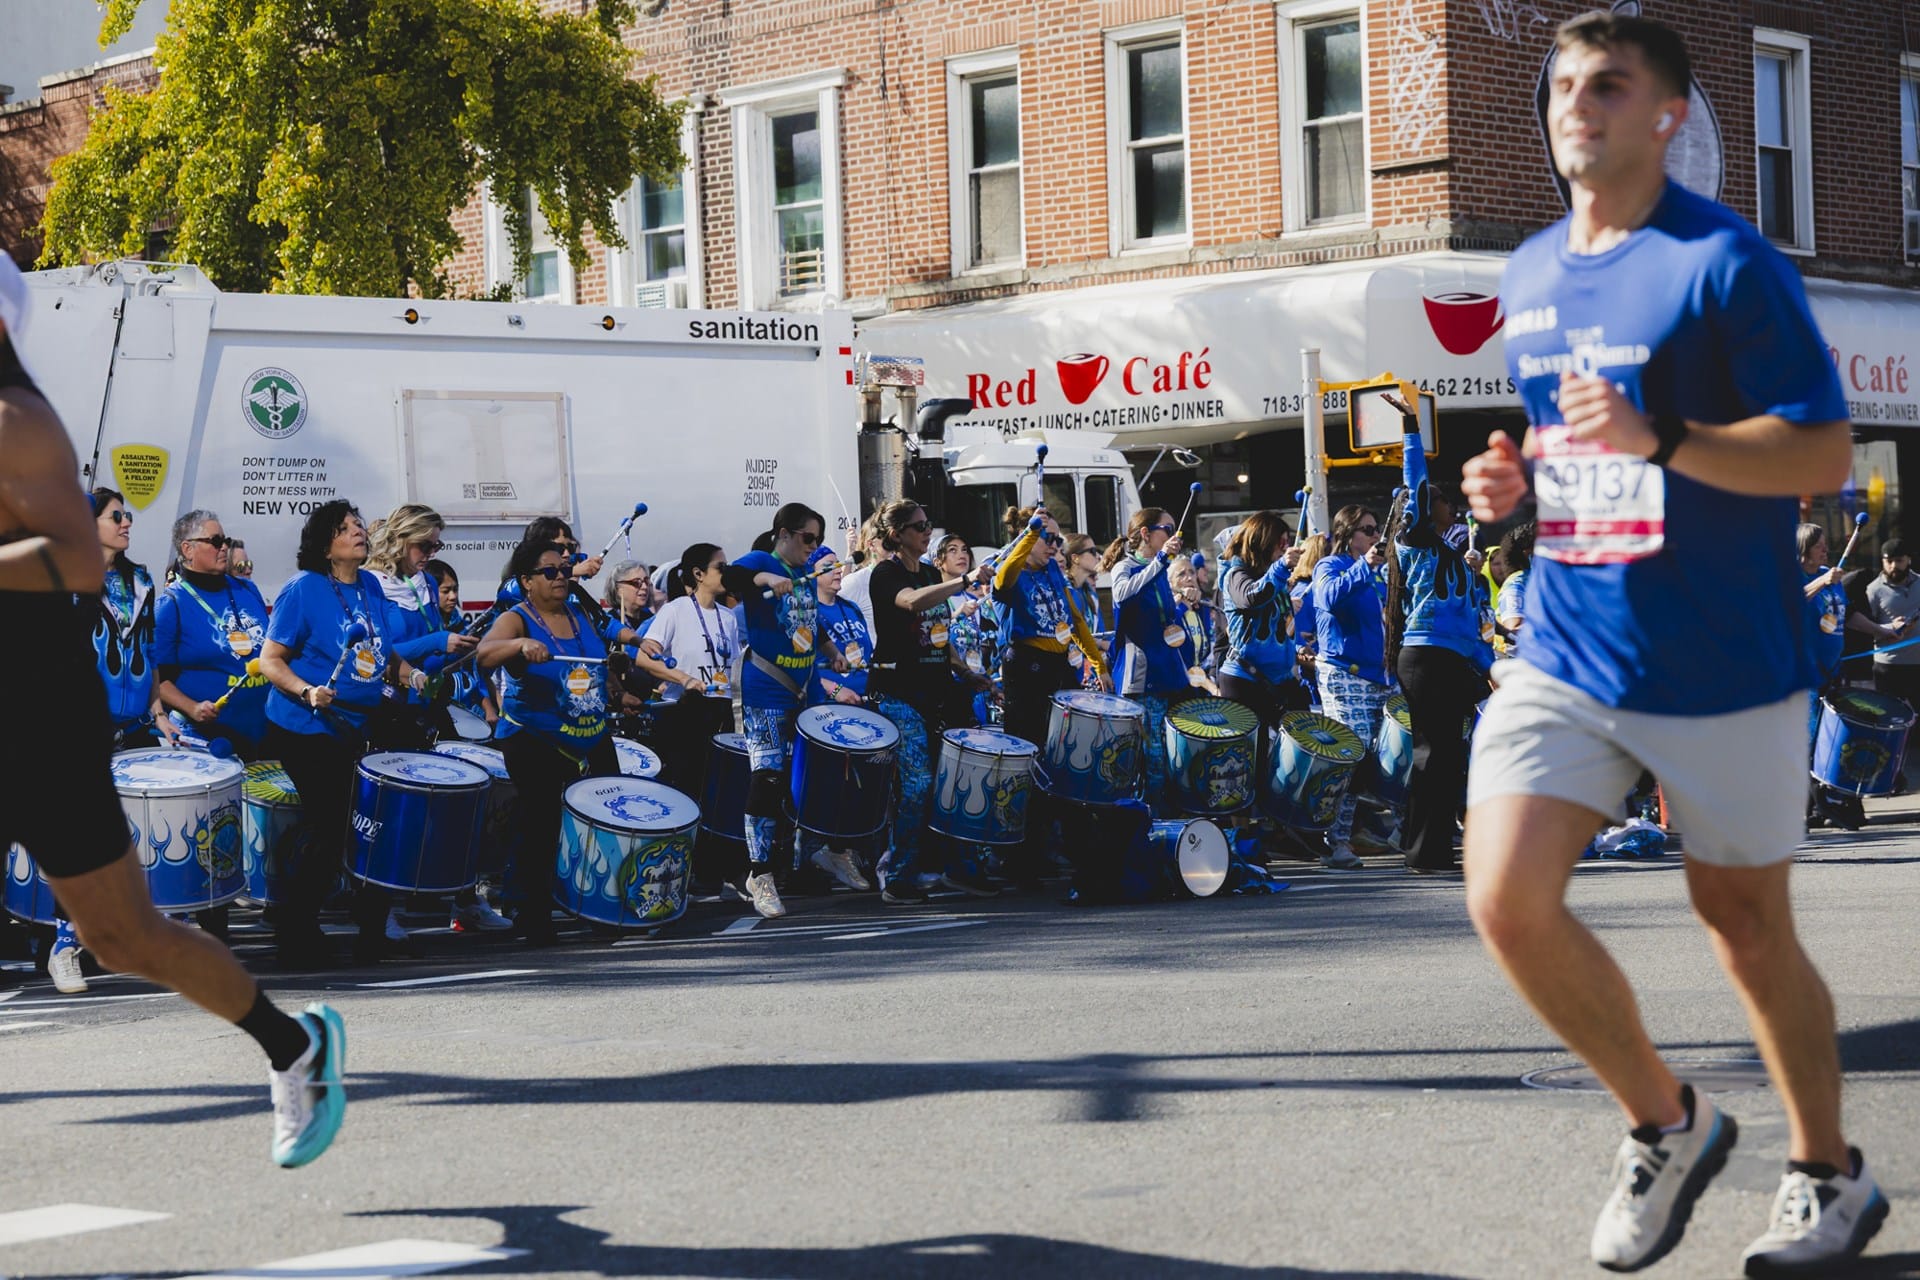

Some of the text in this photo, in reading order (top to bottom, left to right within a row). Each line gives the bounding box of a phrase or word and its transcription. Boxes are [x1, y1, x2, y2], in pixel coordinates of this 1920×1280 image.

[689, 316, 819, 341] sanitation
[252, 371, 264, 382] NEW
[283, 373, 296, 384] CITY
[966, 348, 1212, 410] Red Café
[1850, 354, 1908, 394] Café
[1410, 378, 1456, 396] 4-62
[1463, 377, 1500, 396] 21st
[1093, 404, 1160, 427] CATERING
[1172, 400, 1224, 420] DINNER
[1885, 403, 1919, 420] DINNER
[245, 407, 272, 435] DEPARTMENT
[282, 408, 305, 436] SANITATION
[242, 457, 326, 468] DON'T DUMP ON
[746, 459, 778, 474] NJDEP
[243, 471, 327, 482] DON'T LITTER IN
[748, 476, 775, 490] 20947
[243, 486, 336, 496] DON'T MESS WITH
[765, 493, 779, 507] YDS
[243, 501, 324, 515] NEW YOR
[456, 542, 485, 551] social
[489, 541, 519, 550] @NYC
[578, 715, 597, 725] NYC
[815, 711, 834, 721] GOPE
[595, 786, 623, 796] GOPE
